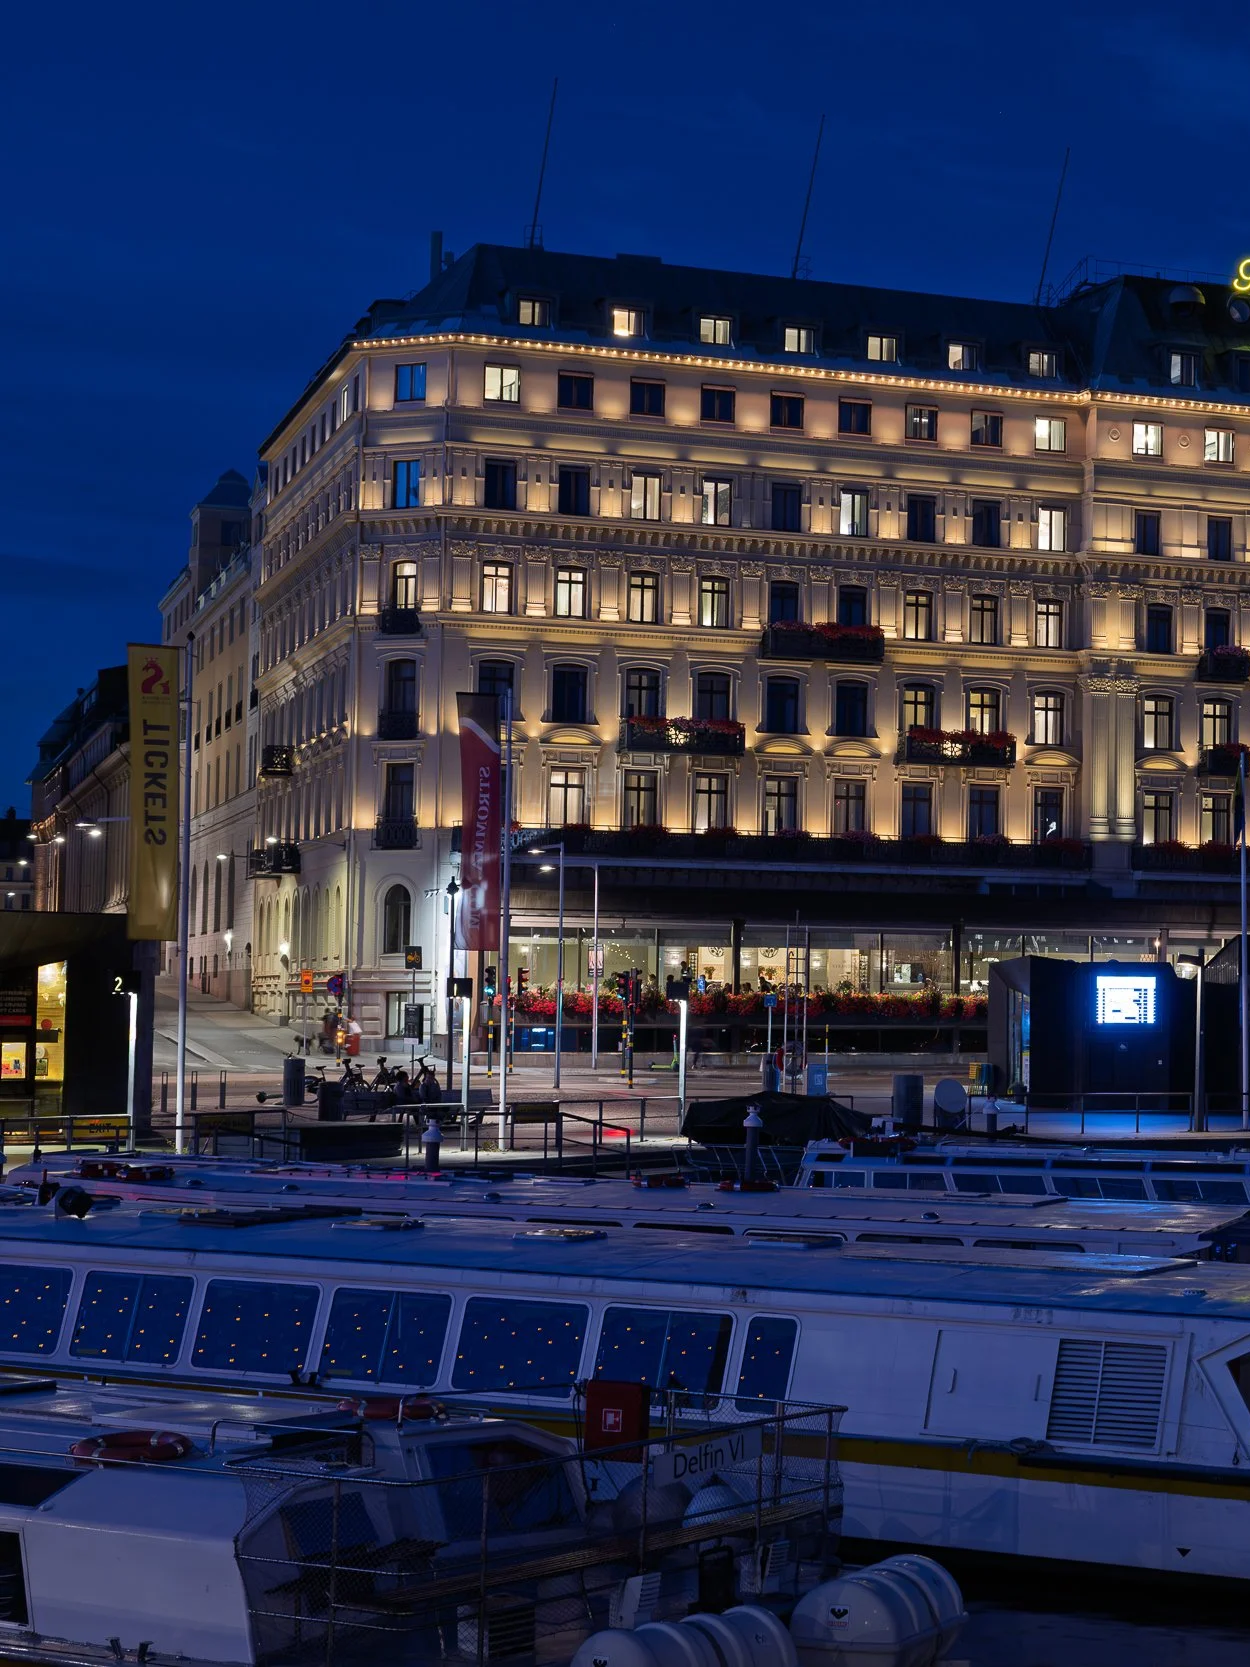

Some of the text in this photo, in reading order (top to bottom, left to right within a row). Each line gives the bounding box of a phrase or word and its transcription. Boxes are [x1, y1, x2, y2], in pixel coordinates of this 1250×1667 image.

[114, 976, 123, 992] 2
[673, 1434, 744, 1479] Delfin VI
